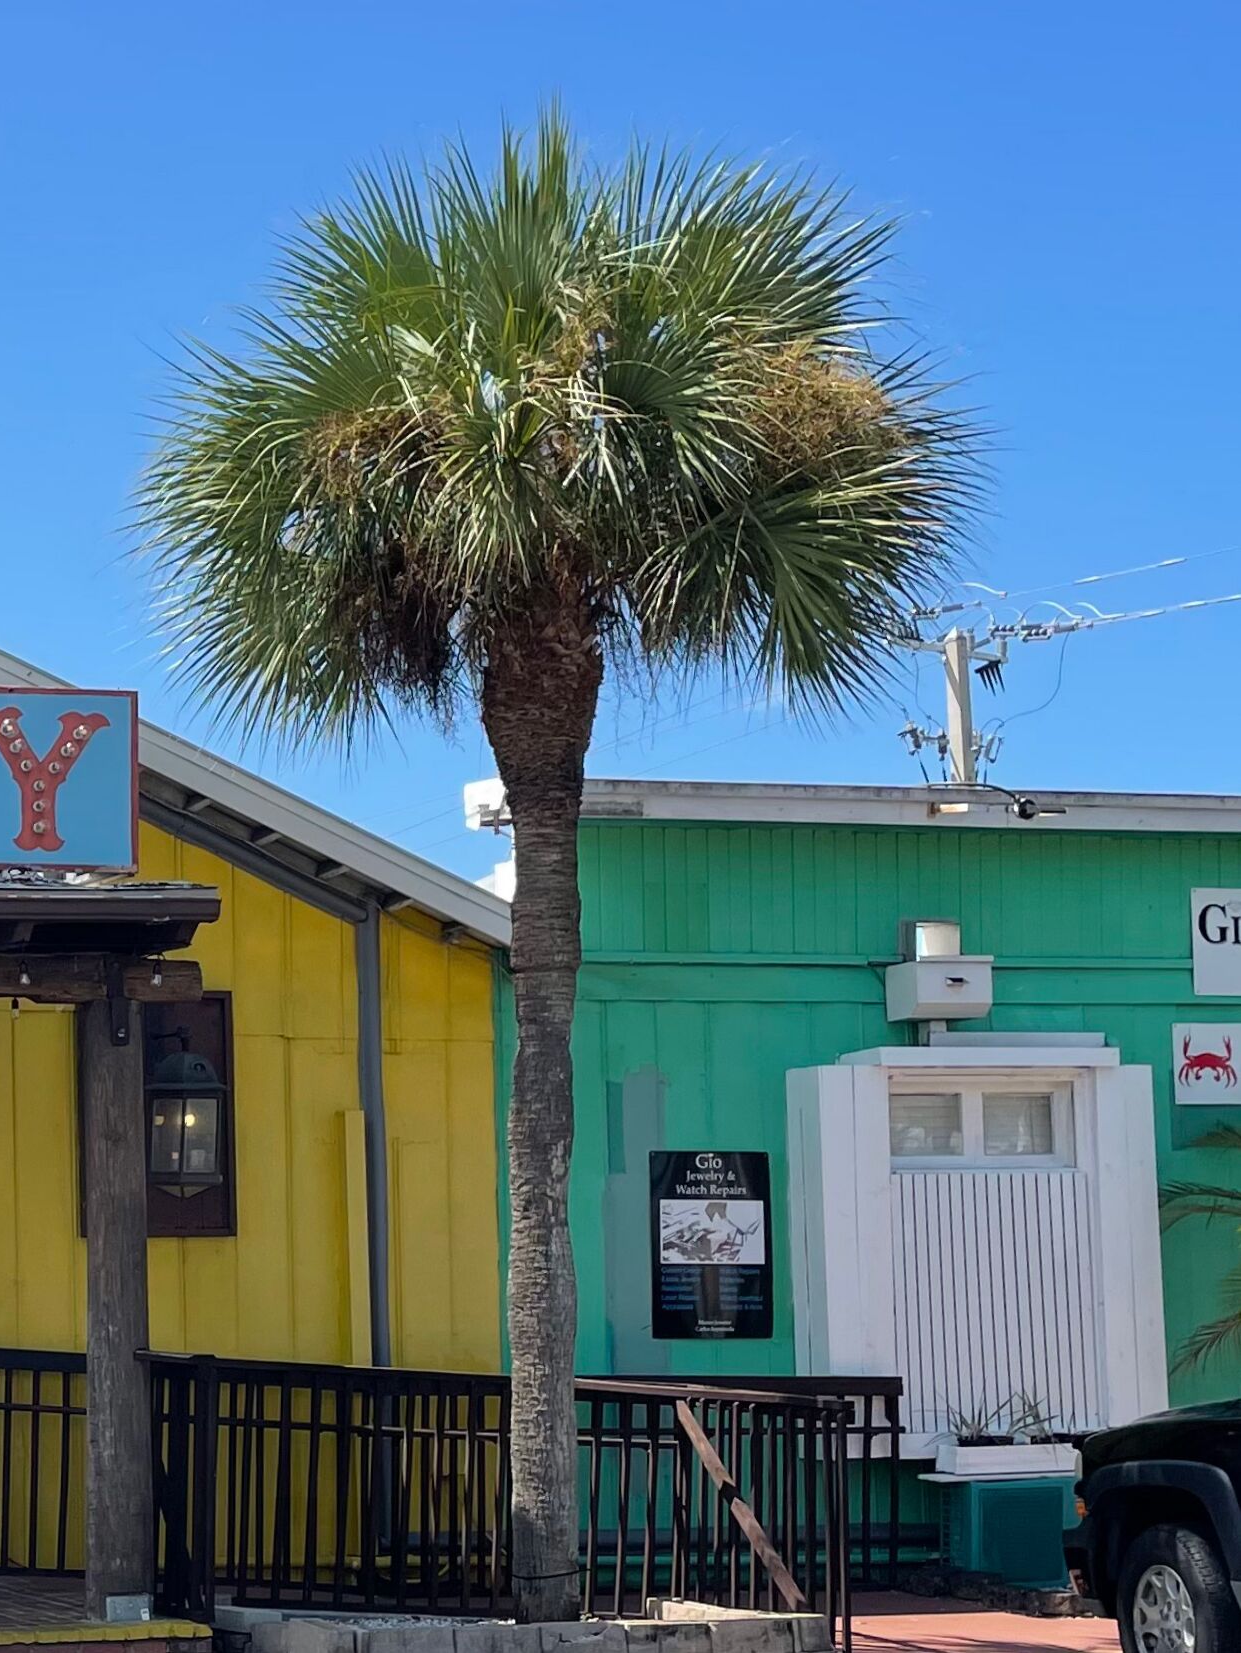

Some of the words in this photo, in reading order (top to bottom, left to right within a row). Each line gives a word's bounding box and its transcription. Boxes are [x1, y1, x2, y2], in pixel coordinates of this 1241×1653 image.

[695, 1153, 723, 1169] Gio
[685, 1170, 725, 1184] Jewelry
[726, 1170, 736, 1181] &
[675, 1184, 708, 1195] Watch
[709, 1184, 747, 1198] Repairs
